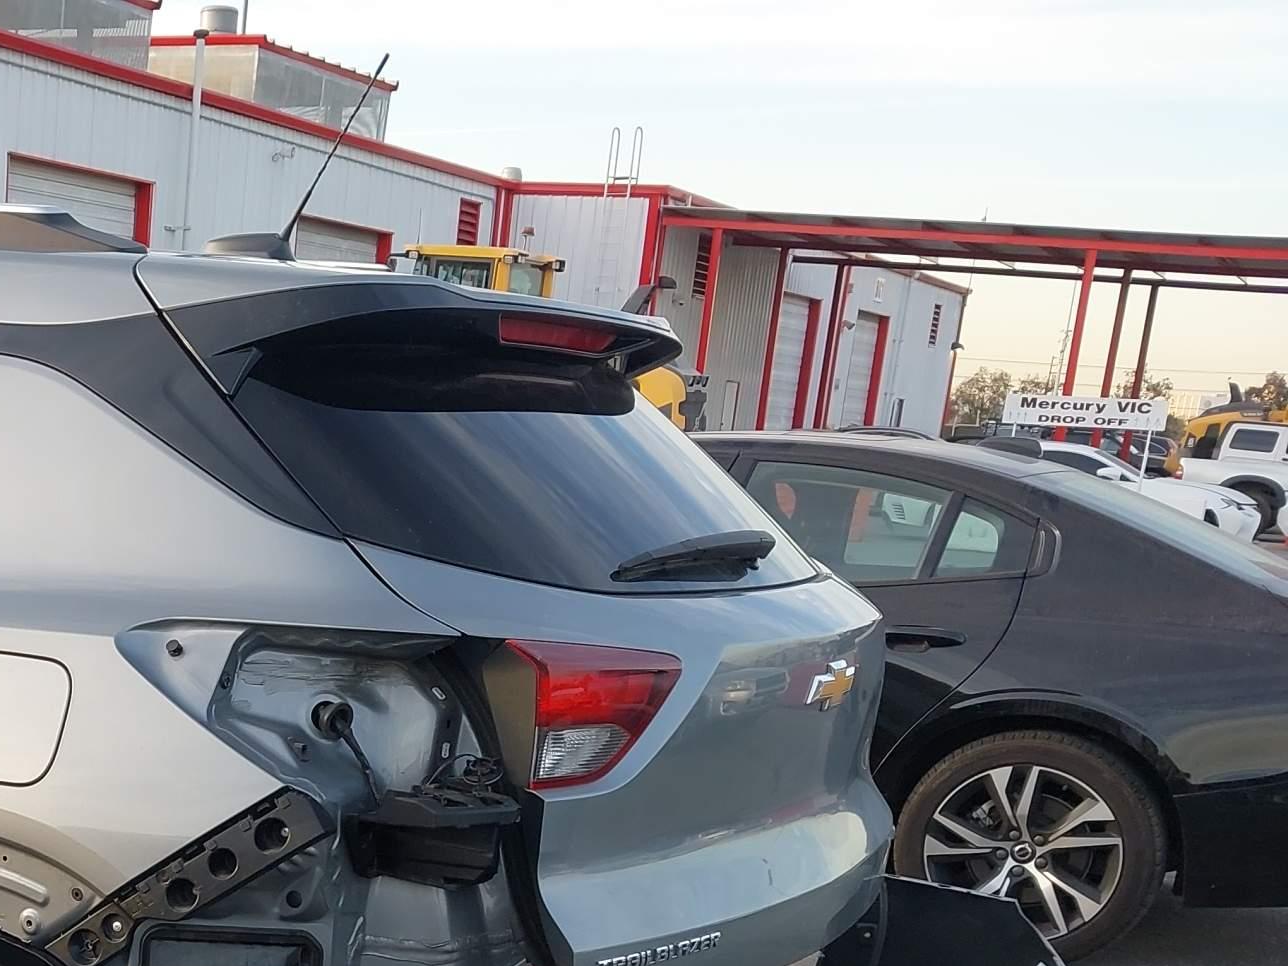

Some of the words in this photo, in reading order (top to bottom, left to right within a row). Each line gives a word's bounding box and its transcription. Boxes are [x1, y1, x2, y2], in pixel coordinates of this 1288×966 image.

[1020, 397, 1107, 414] Mercury
[1117, 401, 1153, 414] VIC
[1038, 414, 1086, 425] DROP
[1093, 416, 1129, 426] OFF
